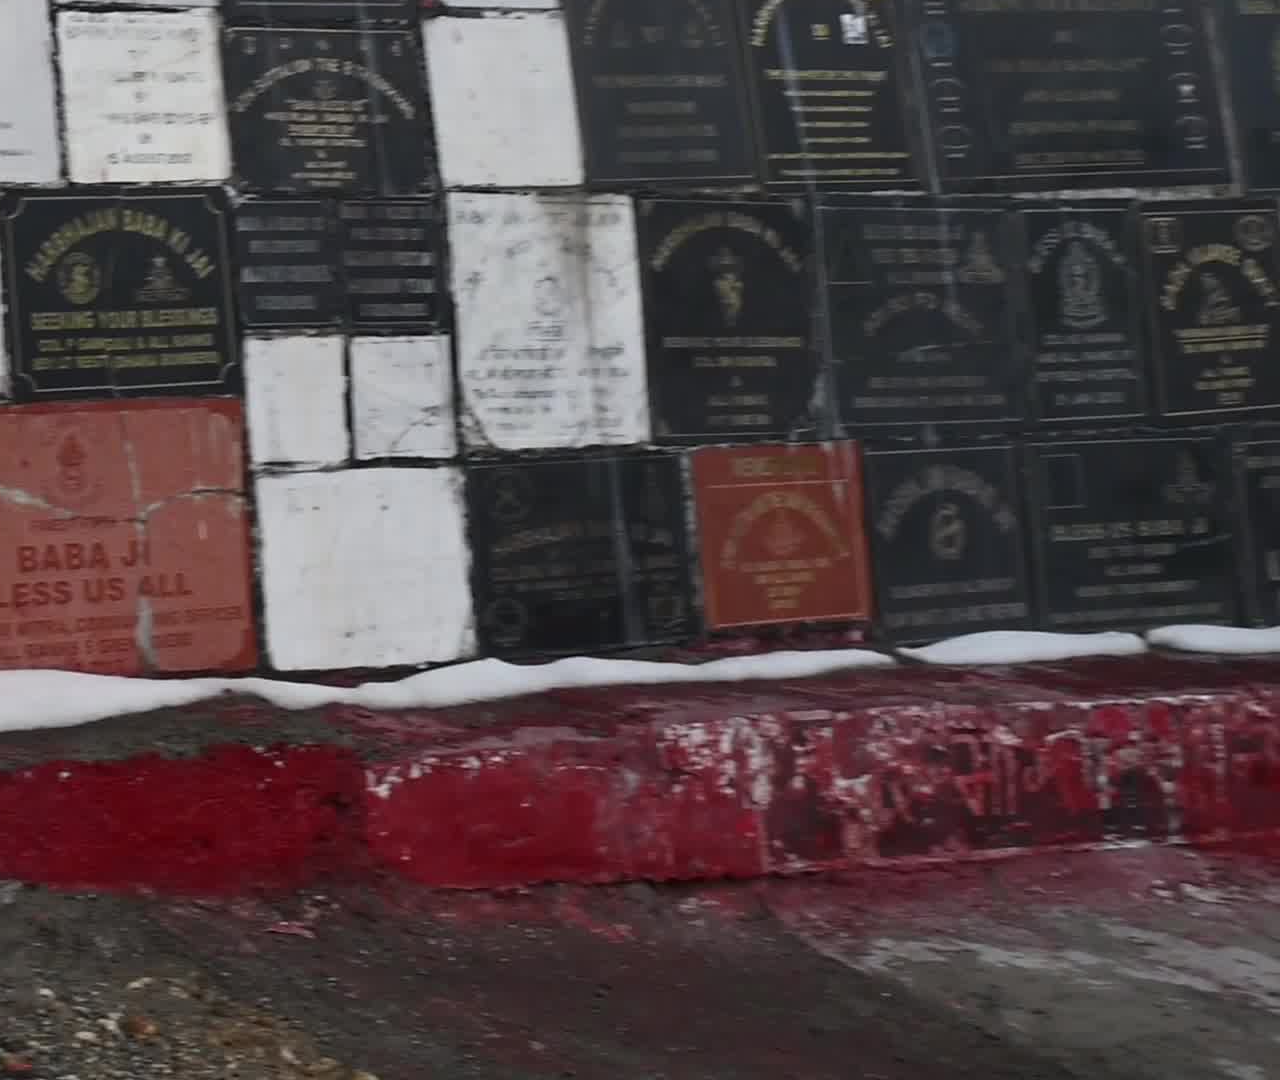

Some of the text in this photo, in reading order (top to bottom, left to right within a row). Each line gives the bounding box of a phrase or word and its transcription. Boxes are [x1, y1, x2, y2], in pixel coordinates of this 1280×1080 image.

[16, 538, 152, 573] BABA JI
[82, 577, 127, 605] US
[137, 572, 194, 599] ALL
